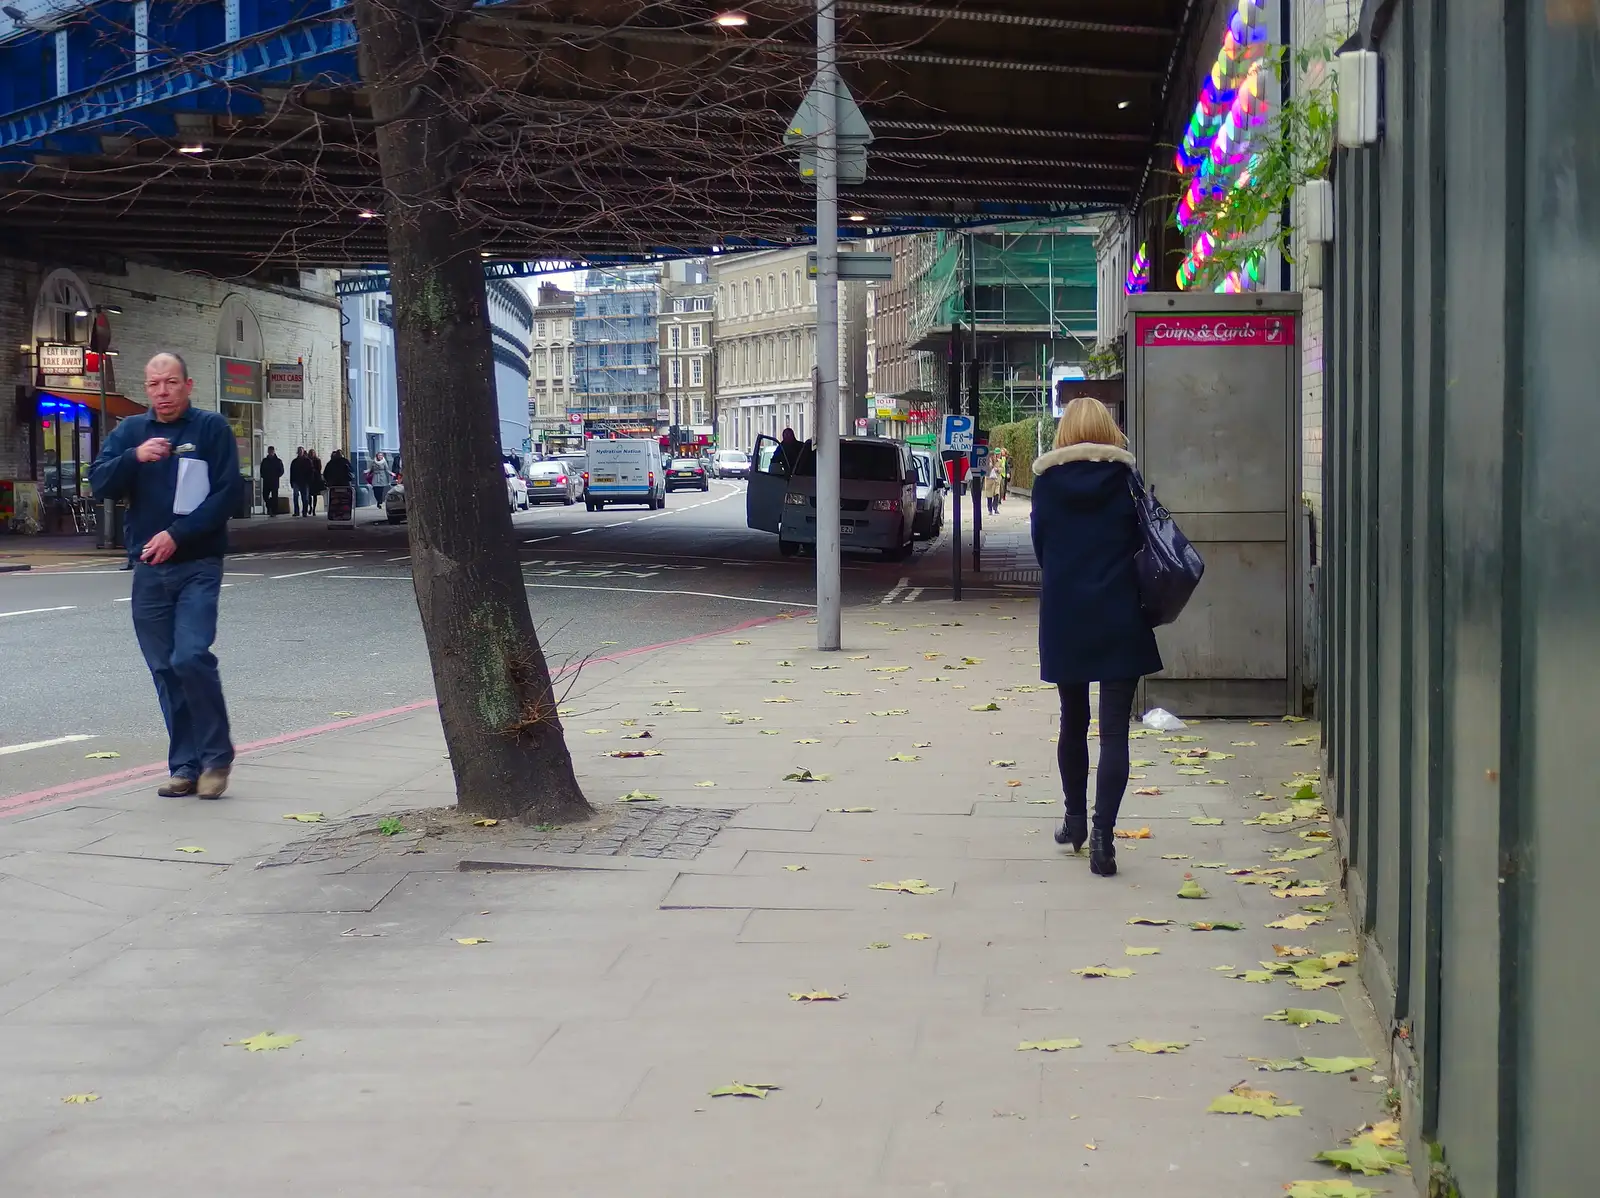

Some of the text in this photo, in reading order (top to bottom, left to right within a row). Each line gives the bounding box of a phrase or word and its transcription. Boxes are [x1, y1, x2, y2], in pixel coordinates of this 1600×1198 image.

[1154, 322, 1256, 339] Coins & Cards
[46, 347, 58, 356] EAT
[60, 347, 68, 356] IN
[43, 357, 82, 366] TAKE AWAY
[271, 373, 303, 382] MINI CABS
[945, 415, 972, 446] P
[950, 443, 960, 451] ALL
[970, 445, 989, 468] P
